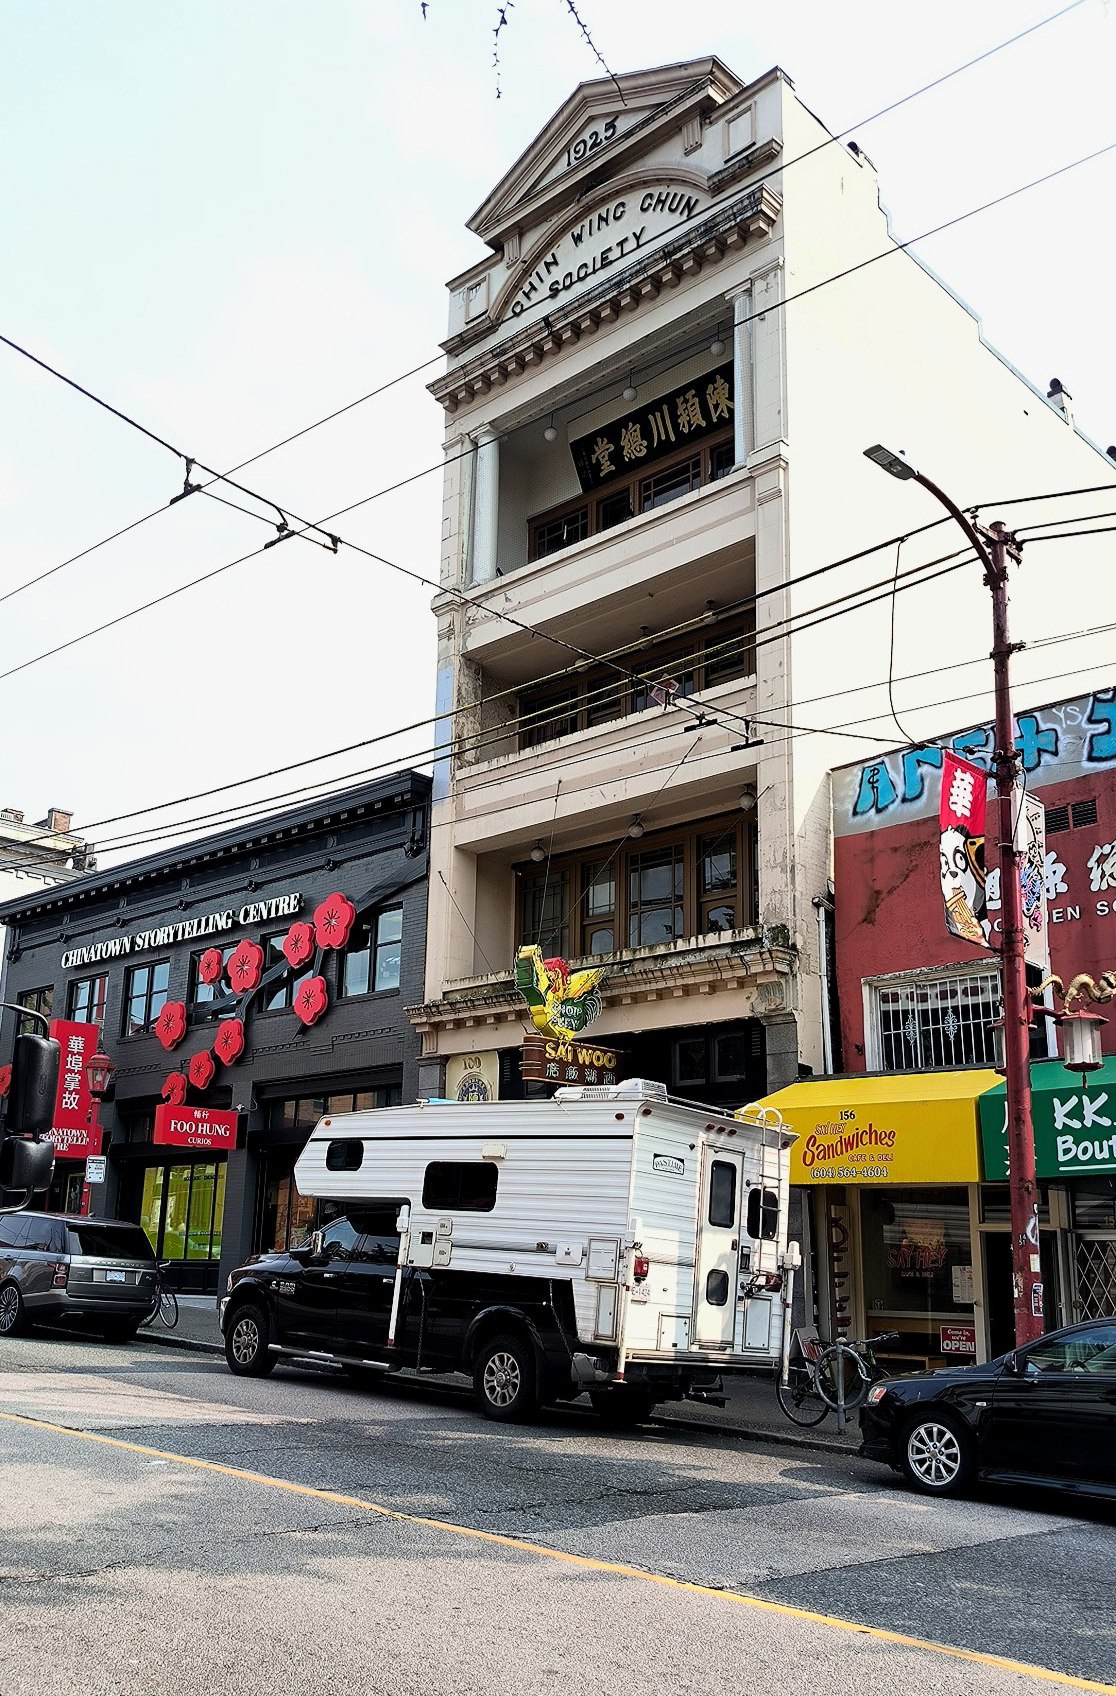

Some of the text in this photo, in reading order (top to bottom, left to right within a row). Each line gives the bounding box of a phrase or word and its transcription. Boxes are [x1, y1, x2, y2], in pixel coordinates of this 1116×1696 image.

[566, 115, 619, 167] 1925
[511, 191, 700, 317] CHIN WING CHUN
[549, 226, 646, 299] SOCIETY
[61, 892, 301, 969] CHINATOWN STORYTELLING CENTRE
[551, 1002, 583, 1017] CHOP
[545, 1041, 616, 1068] SAI WOO
[61, 1035, 85, 1110] 華埠掌故
[840, 1110, 855, 1120] 156
[170, 1120, 230, 1136] FOO HUNG
[815, 1122, 847, 1135] SAY HEY
[187, 1137, 212, 1145] CURIOS
[802, 1123, 896, 1167] Sandwiches
[848, 1154, 866, 1162] CAFE
[869, 1154, 875, 1162] &
[811, 1166, 888, 1178] (604) 564-4604
[887, 1247, 948, 1268] SAY HEY
[943, 1340, 975, 1351] OPEN
